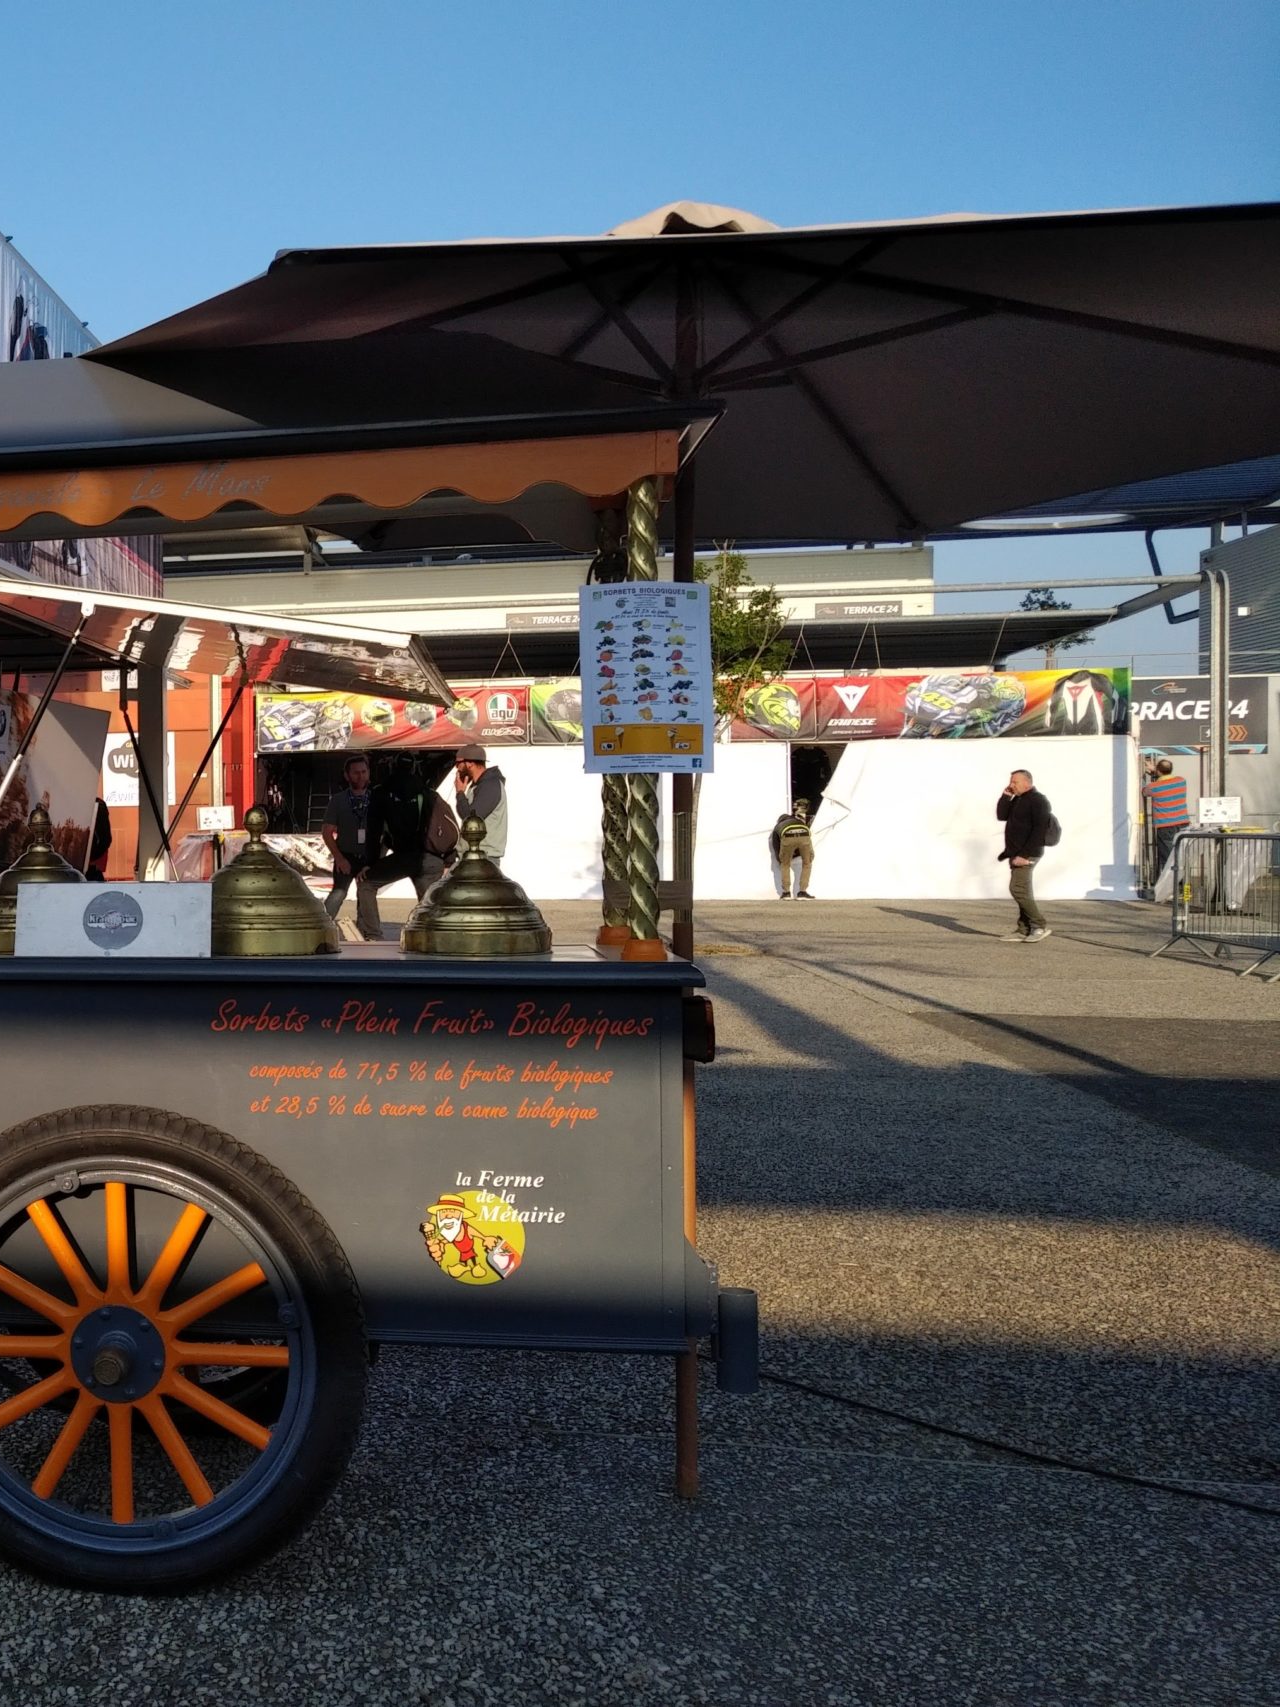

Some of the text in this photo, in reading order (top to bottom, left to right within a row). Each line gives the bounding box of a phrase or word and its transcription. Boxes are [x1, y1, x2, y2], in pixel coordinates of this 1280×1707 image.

[130, 471, 167, 501] Le
[182, 461, 272, 499] Mans
[603, 587, 686, 596] SORBETS BIOLOGIQUES
[843, 605, 886, 614] TERRACE
[886, 605, 899, 613] 24
[531, 616, 571, 624] TERRACE
[827, 718, 877, 726] DAINESE
[212, 997, 311, 1032] Sorbets
[507, 999, 654, 1049] Biologiques
[248, 1059, 614, 1093] composés de 71,5 % de fruits biologiques
[248, 1093, 599, 1129] et 28,5 % de sucre de canne biologique
[455, 1169, 545, 1188] la Ferme
[476, 1189, 516, 1204] de la
[477, 1205, 566, 1224] Métairie
